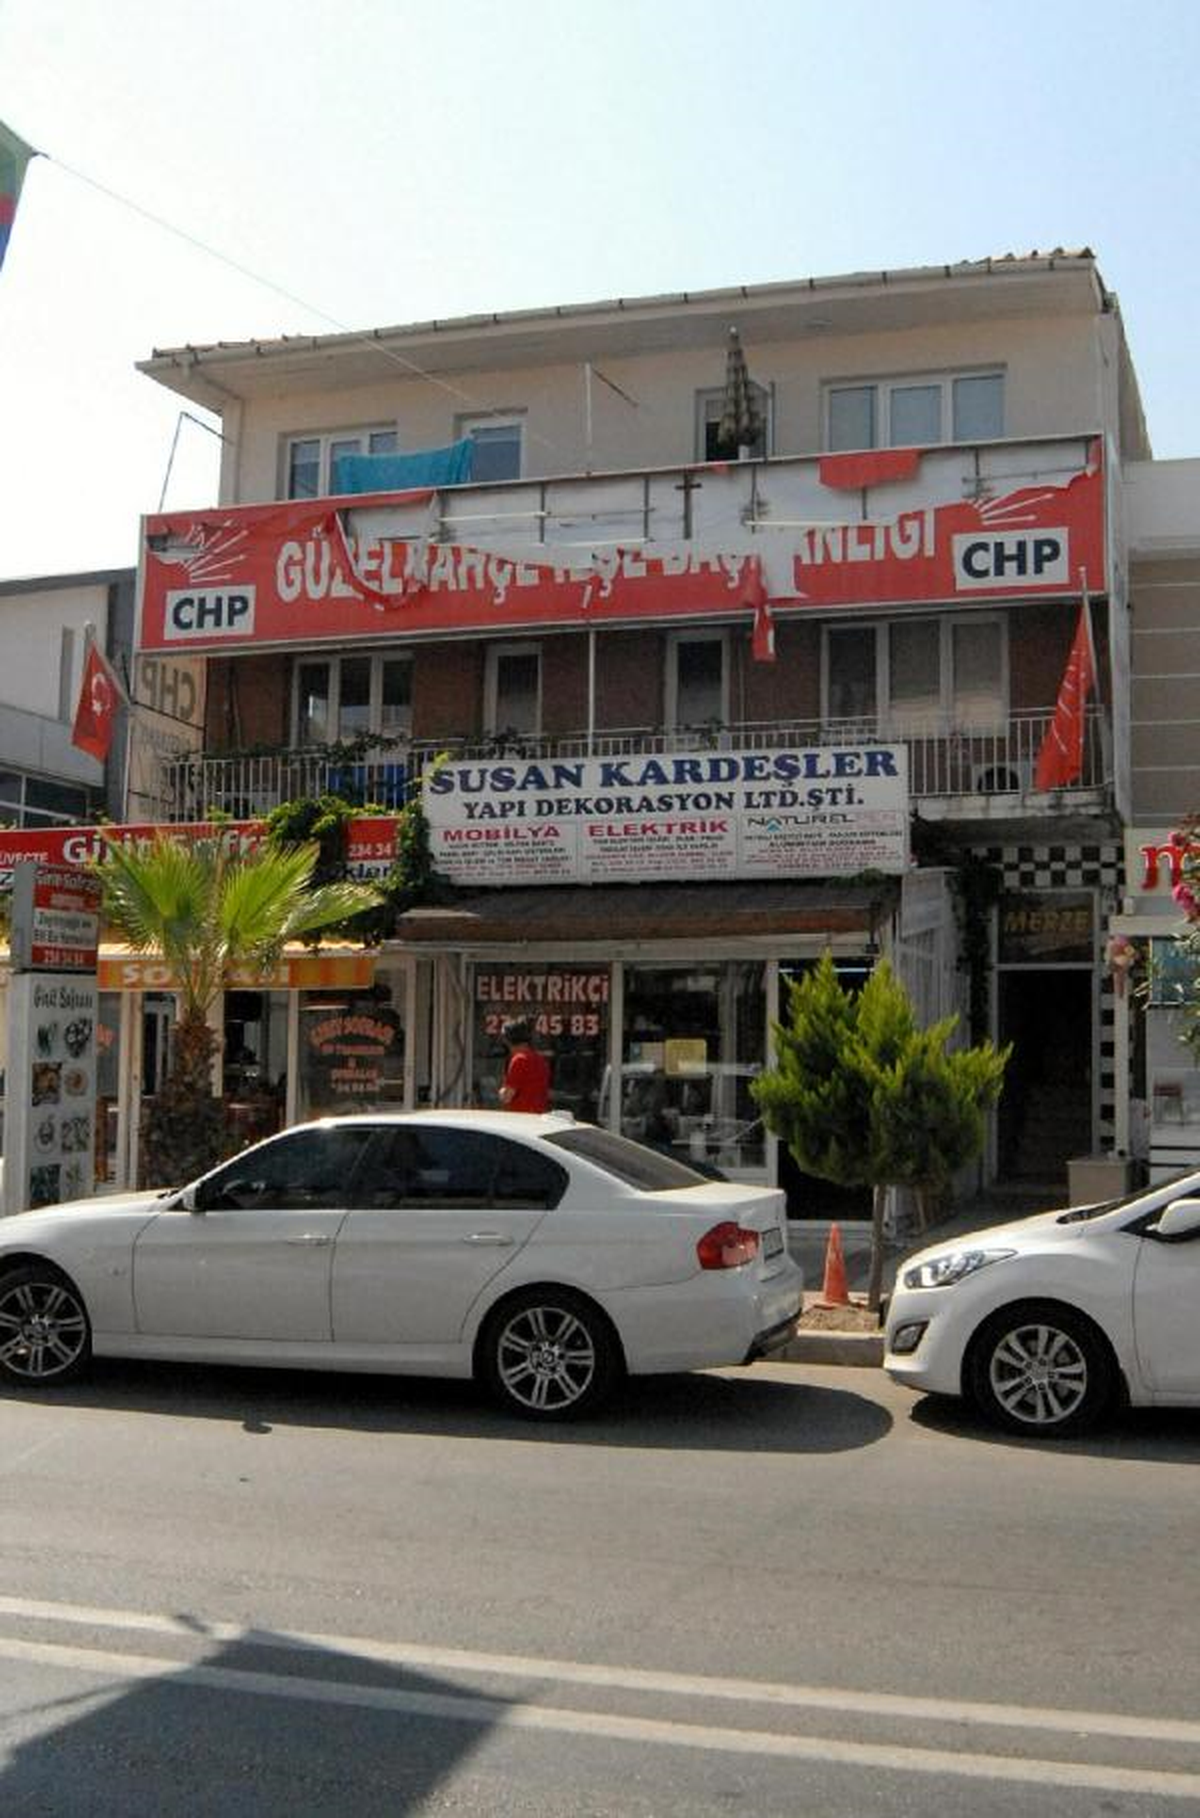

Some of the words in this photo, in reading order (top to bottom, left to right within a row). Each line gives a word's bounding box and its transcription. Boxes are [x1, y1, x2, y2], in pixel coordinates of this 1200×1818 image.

[962, 538, 1061, 579] CHP
[172, 595, 249, 631] CHP
[429, 763, 585, 794] SUSAN
[600, 750, 898, 788] KARDEŞLER
[463, 800, 527, 820] YAPI
[535, 791, 735, 817] DEKORASYON
[443, 825, 560, 843] MOBİLYA
[477, 974, 609, 1008] ELEKTRİKÇİ
[535, 1014, 563, 1036] 45
[570, 1014, 599, 1036] 83
